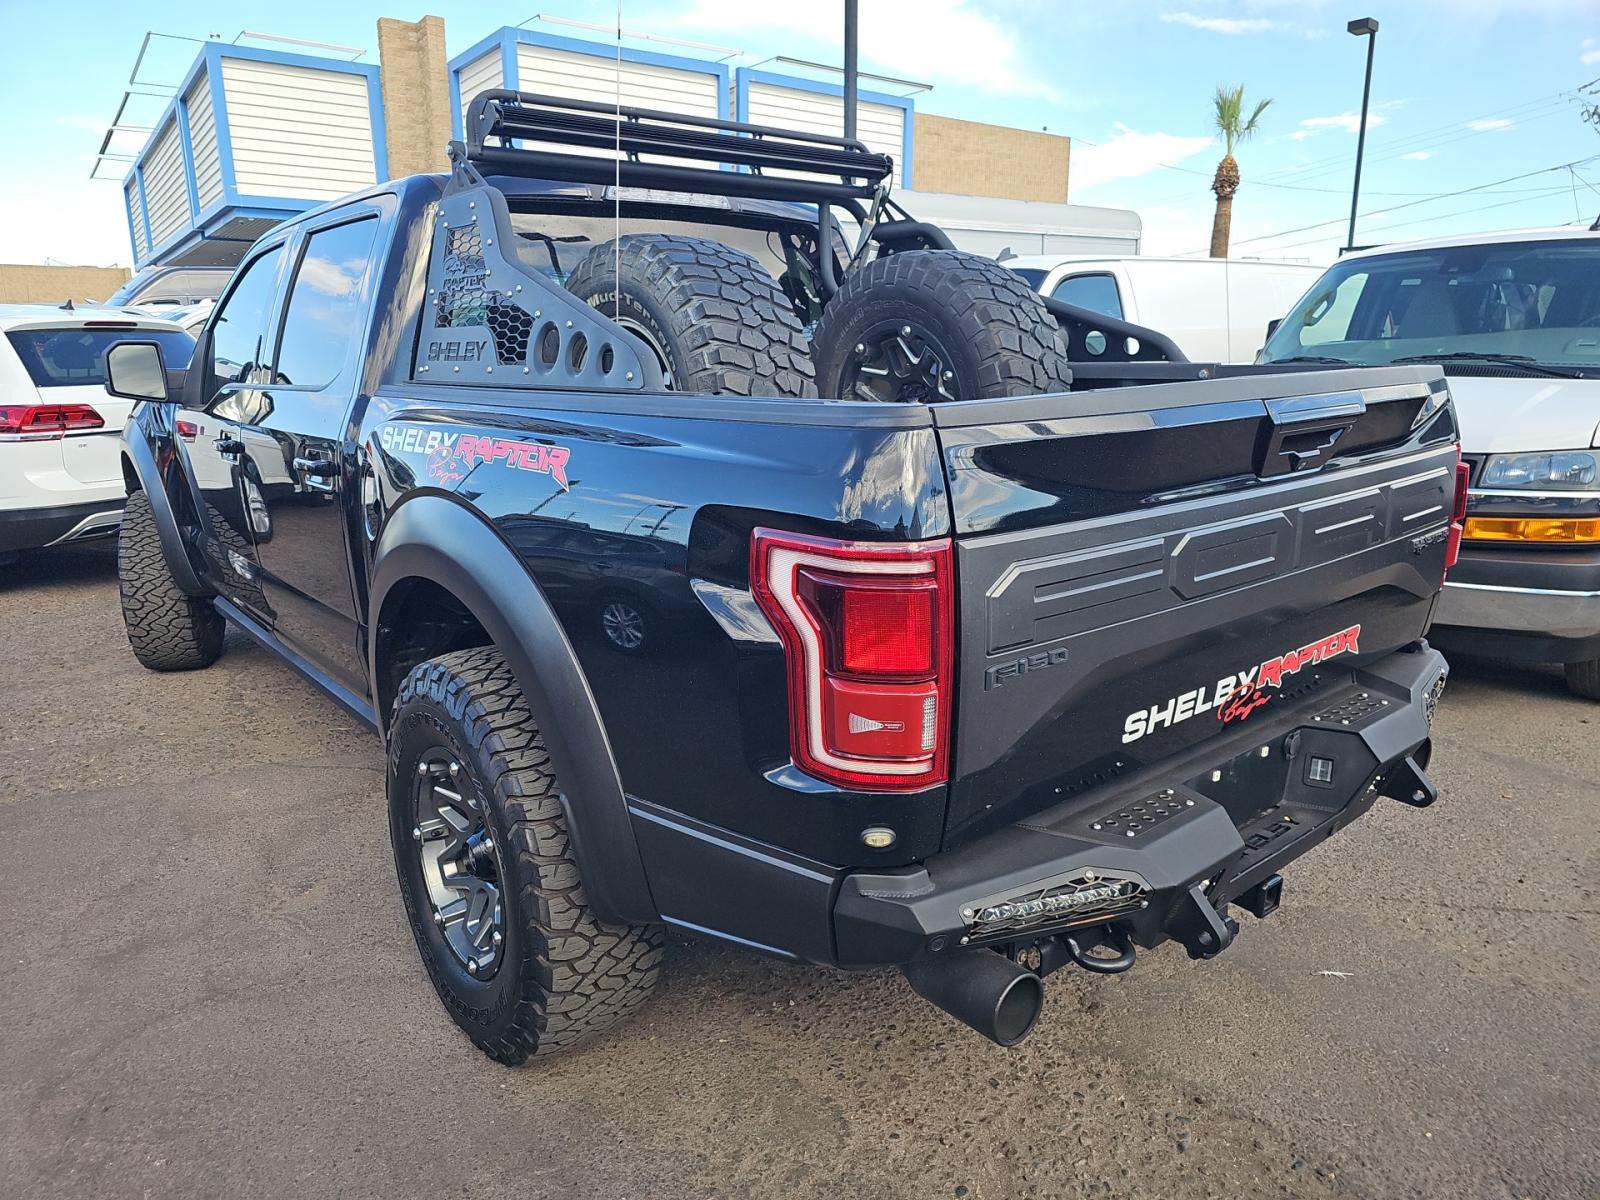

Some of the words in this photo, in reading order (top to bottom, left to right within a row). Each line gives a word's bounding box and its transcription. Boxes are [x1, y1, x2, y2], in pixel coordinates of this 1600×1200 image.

[428, 341, 487, 361] SHELBY
[381, 426, 459, 456] SHELBY
[454, 434, 570, 492] RAPTOR
[985, 467, 1451, 654] FORD
[1122, 666, 1259, 744] SHELBY
[1256, 624, 1361, 688] RAPTOR
[1217, 683, 1272, 724] Baja
